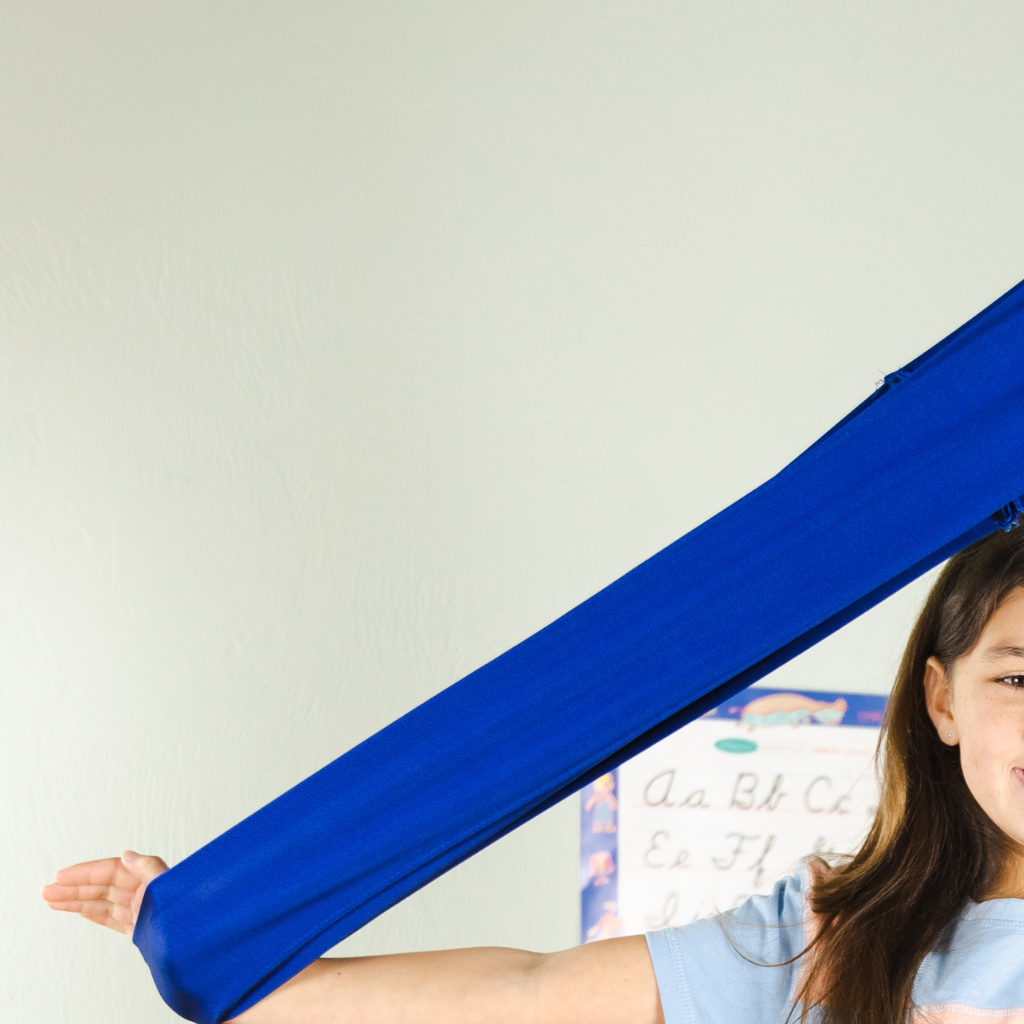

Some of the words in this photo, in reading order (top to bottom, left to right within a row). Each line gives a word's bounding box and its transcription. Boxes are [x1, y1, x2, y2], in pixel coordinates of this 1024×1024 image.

[642, 768, 710, 809] Aa
[729, 771, 787, 812] Bb
[803, 774, 850, 814] Cc
[643, 830, 690, 869] Ee
